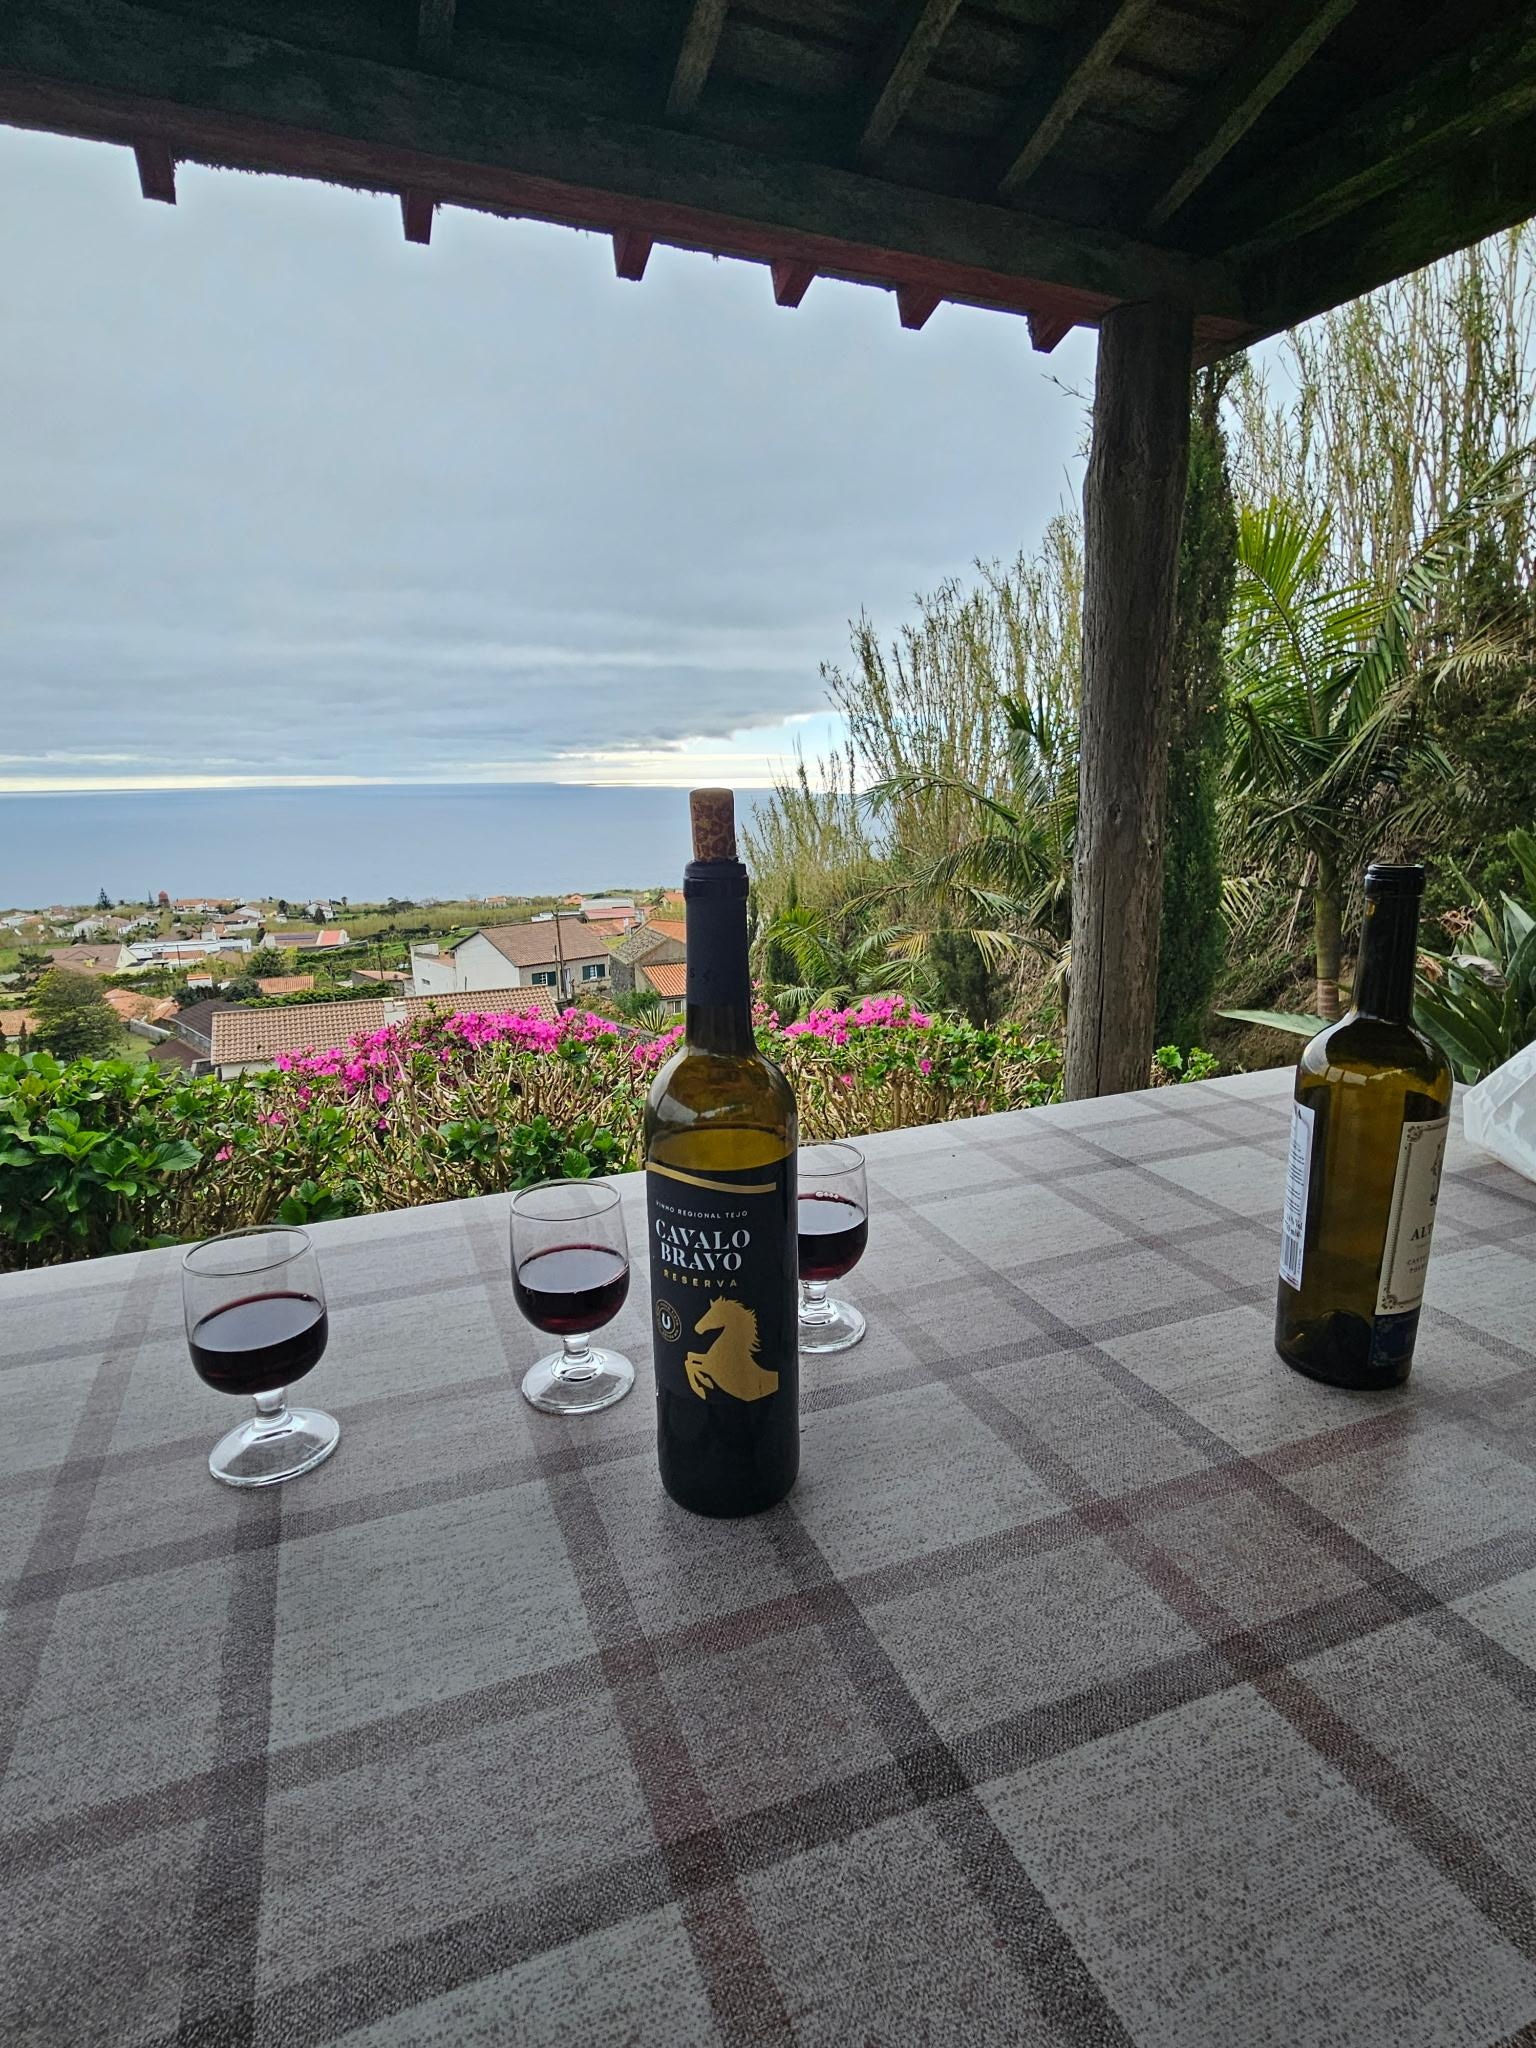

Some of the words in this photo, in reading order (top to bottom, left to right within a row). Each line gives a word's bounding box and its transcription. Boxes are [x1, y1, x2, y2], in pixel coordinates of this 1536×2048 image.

[655, 1201, 675, 1213] VINHO
[677, 1208, 721, 1219] REGIONAL
[725, 1210, 748, 1218] TEJO
[655, 1218, 751, 1250] CAVALO
[660, 1241, 742, 1271] BRAVO
[663, 1268, 738, 1288] RESERVA
